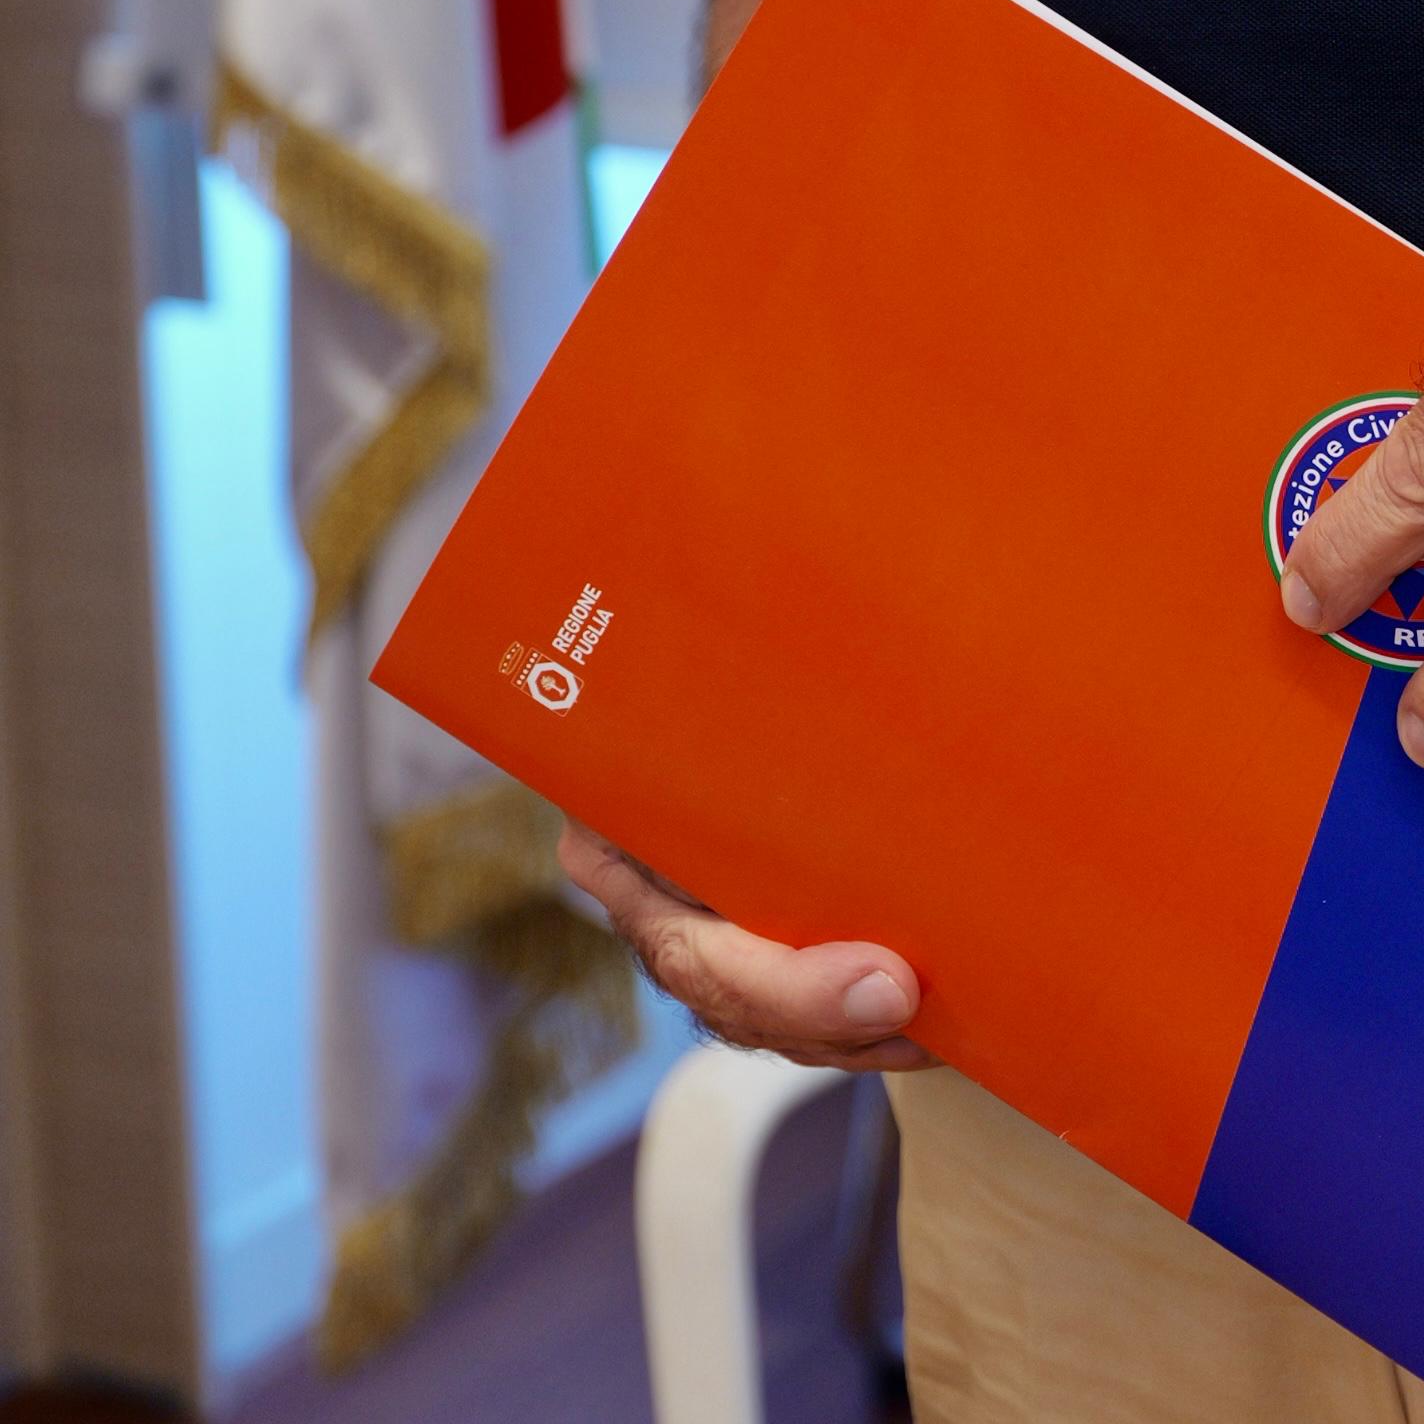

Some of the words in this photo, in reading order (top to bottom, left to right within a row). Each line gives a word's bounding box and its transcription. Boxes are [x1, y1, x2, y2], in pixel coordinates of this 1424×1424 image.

[1288, 440, 1345, 539] tezione
[552, 583, 602, 654] REGIONE
[569, 609, 614, 665] PUGLIA
